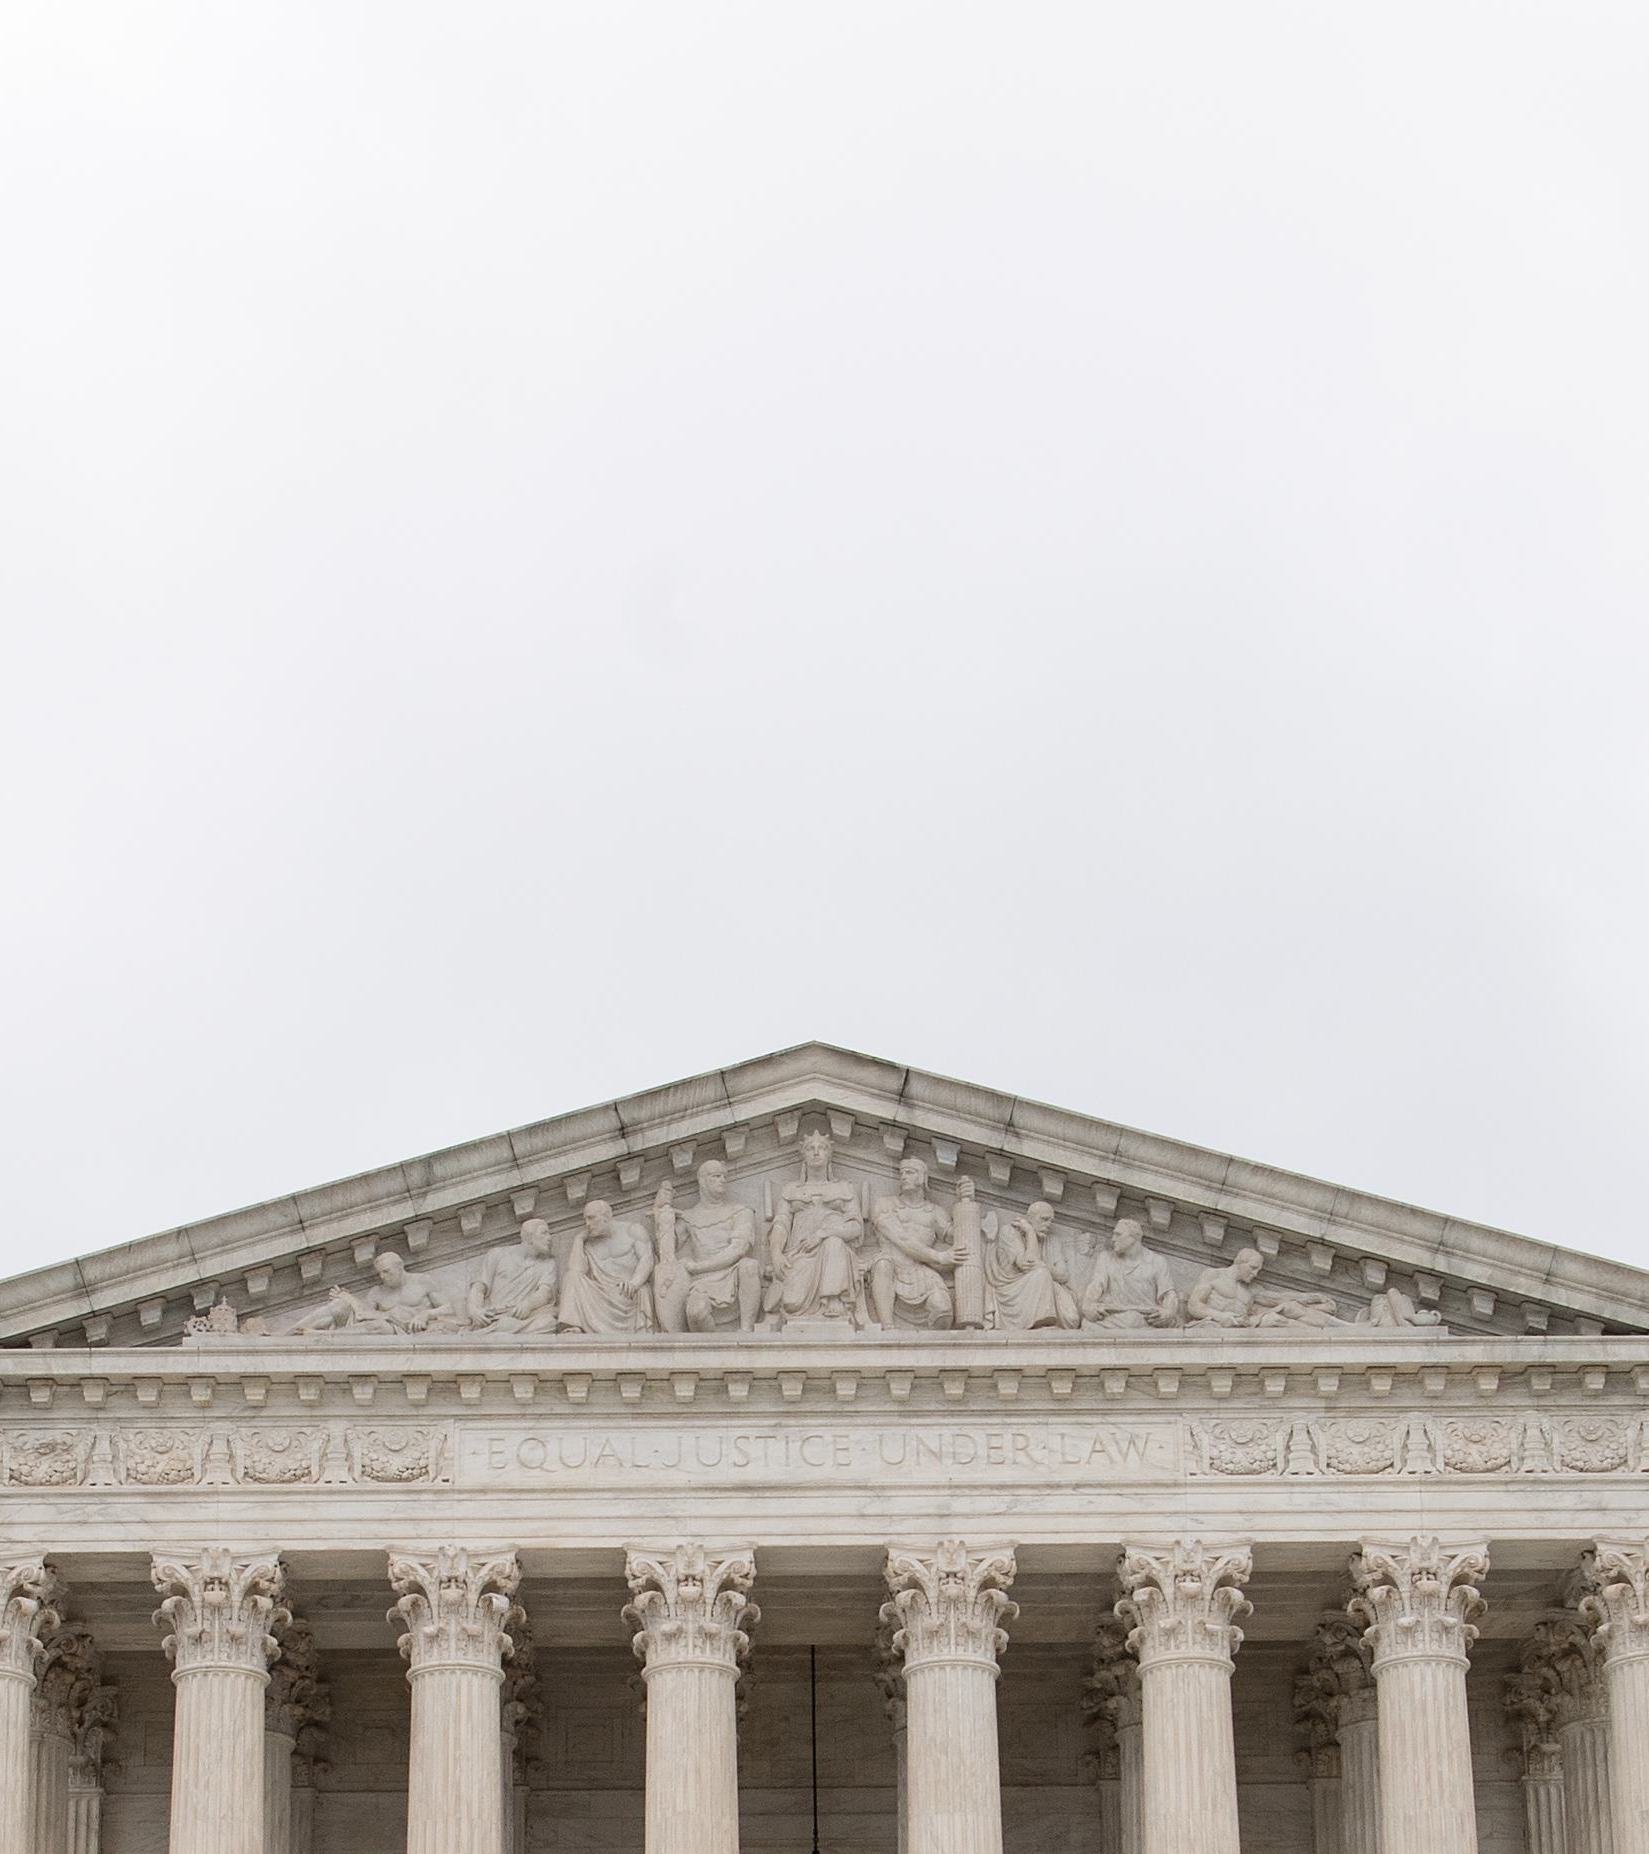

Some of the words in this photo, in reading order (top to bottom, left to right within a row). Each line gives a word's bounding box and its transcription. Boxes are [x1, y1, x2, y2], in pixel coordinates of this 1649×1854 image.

[485, 1435, 651, 1473] EQUAL
[661, 1433, 853, 1469] JUSTICE
[877, 1432, 1046, 1467] UNDER
[1056, 1431, 1153, 1466] LAW
